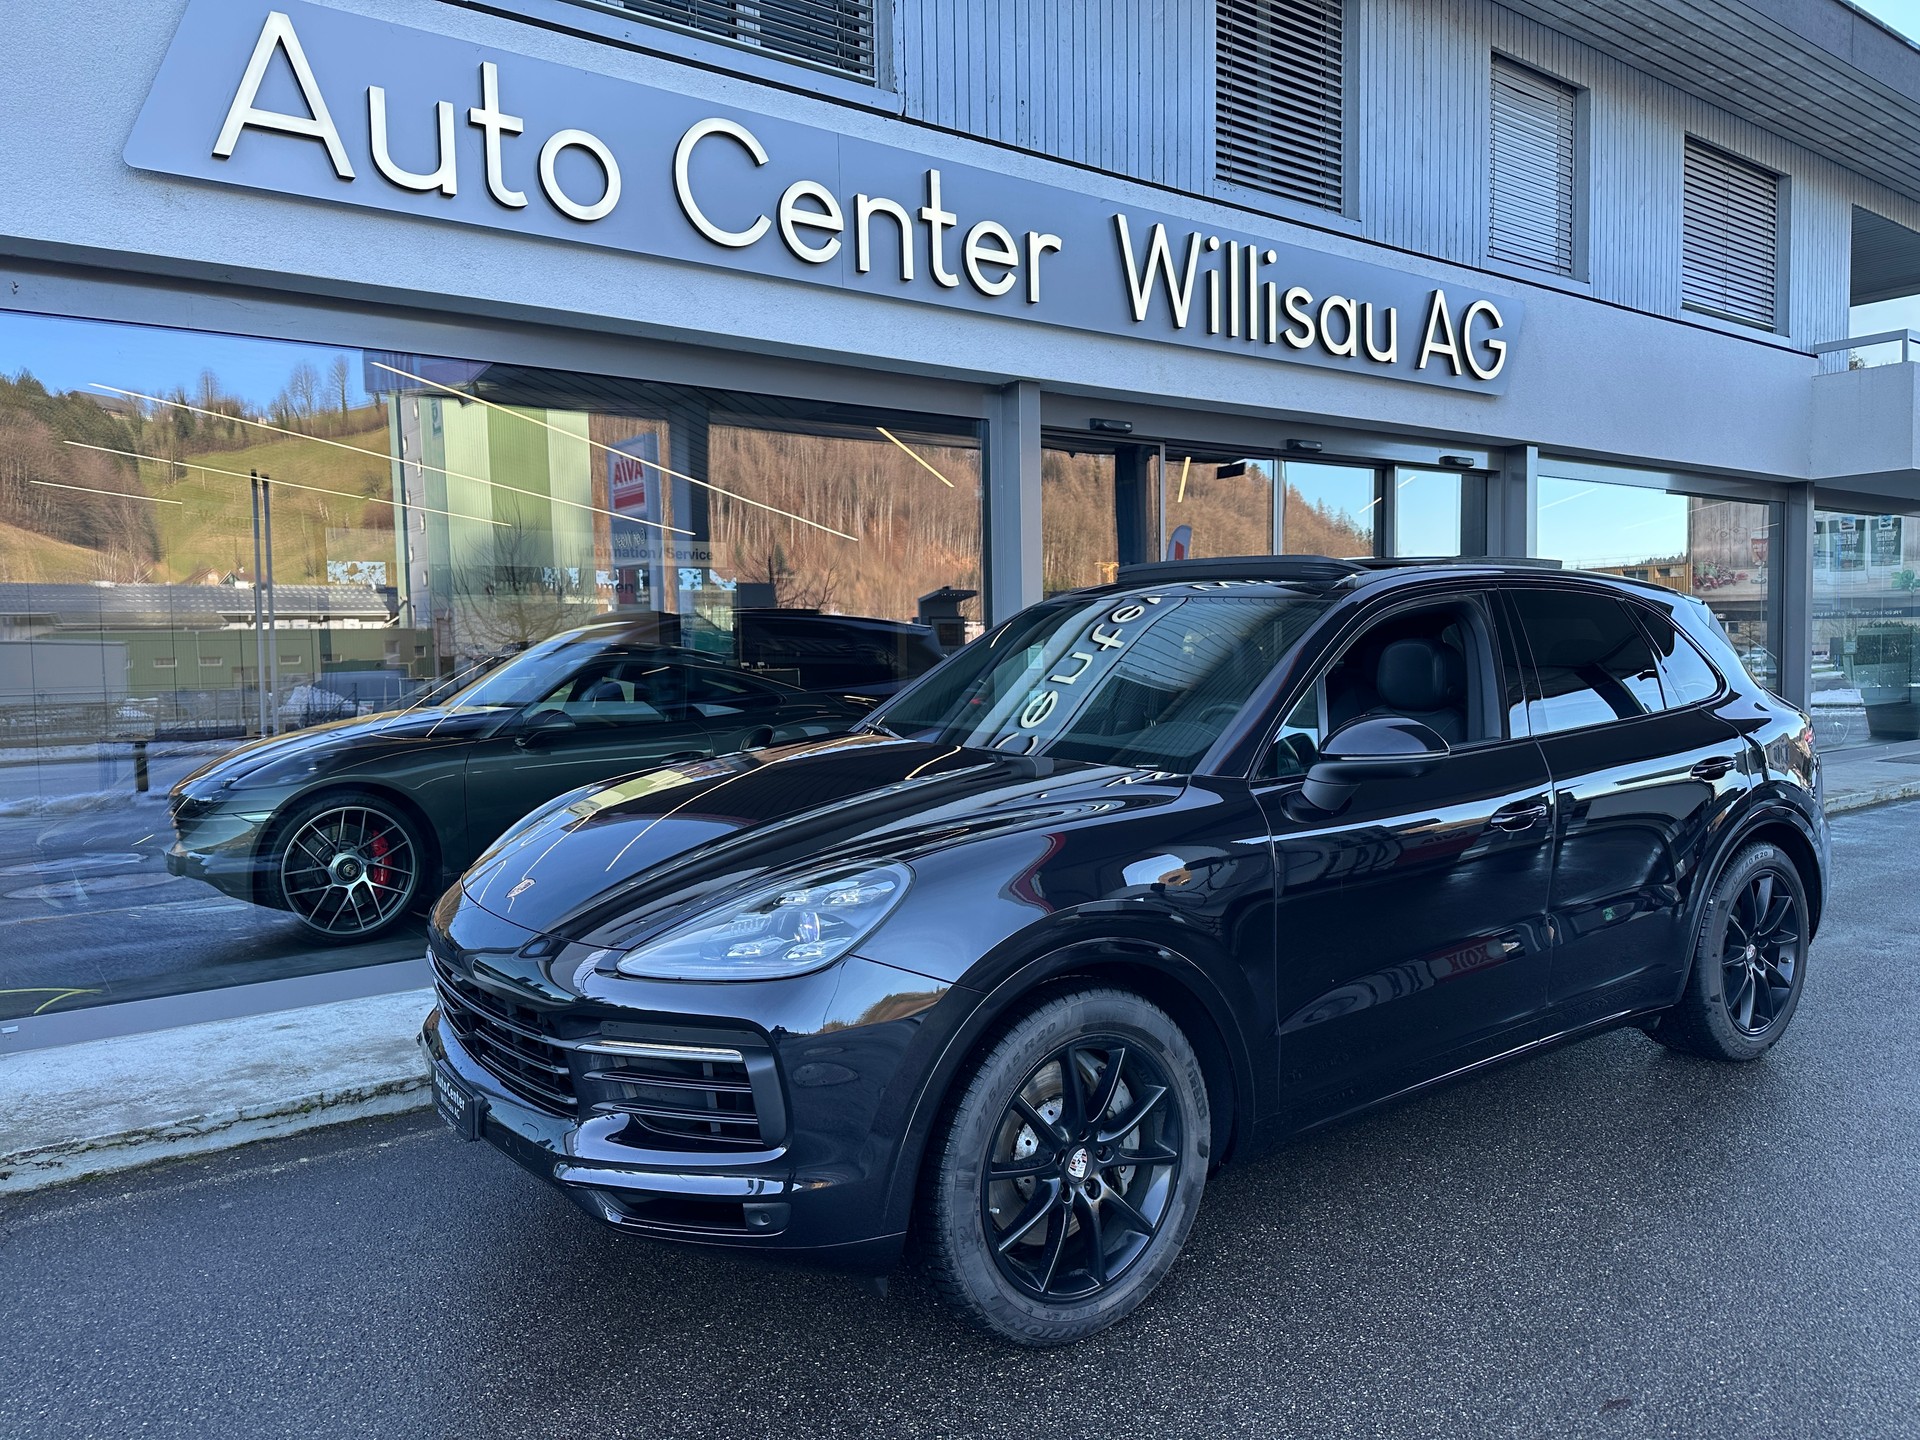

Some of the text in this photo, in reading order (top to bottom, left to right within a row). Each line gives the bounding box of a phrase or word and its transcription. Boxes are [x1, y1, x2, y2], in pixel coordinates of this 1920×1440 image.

[212, 10, 1507, 380] Auto Center Willisau AG
[666, 547, 713, 561] Service
